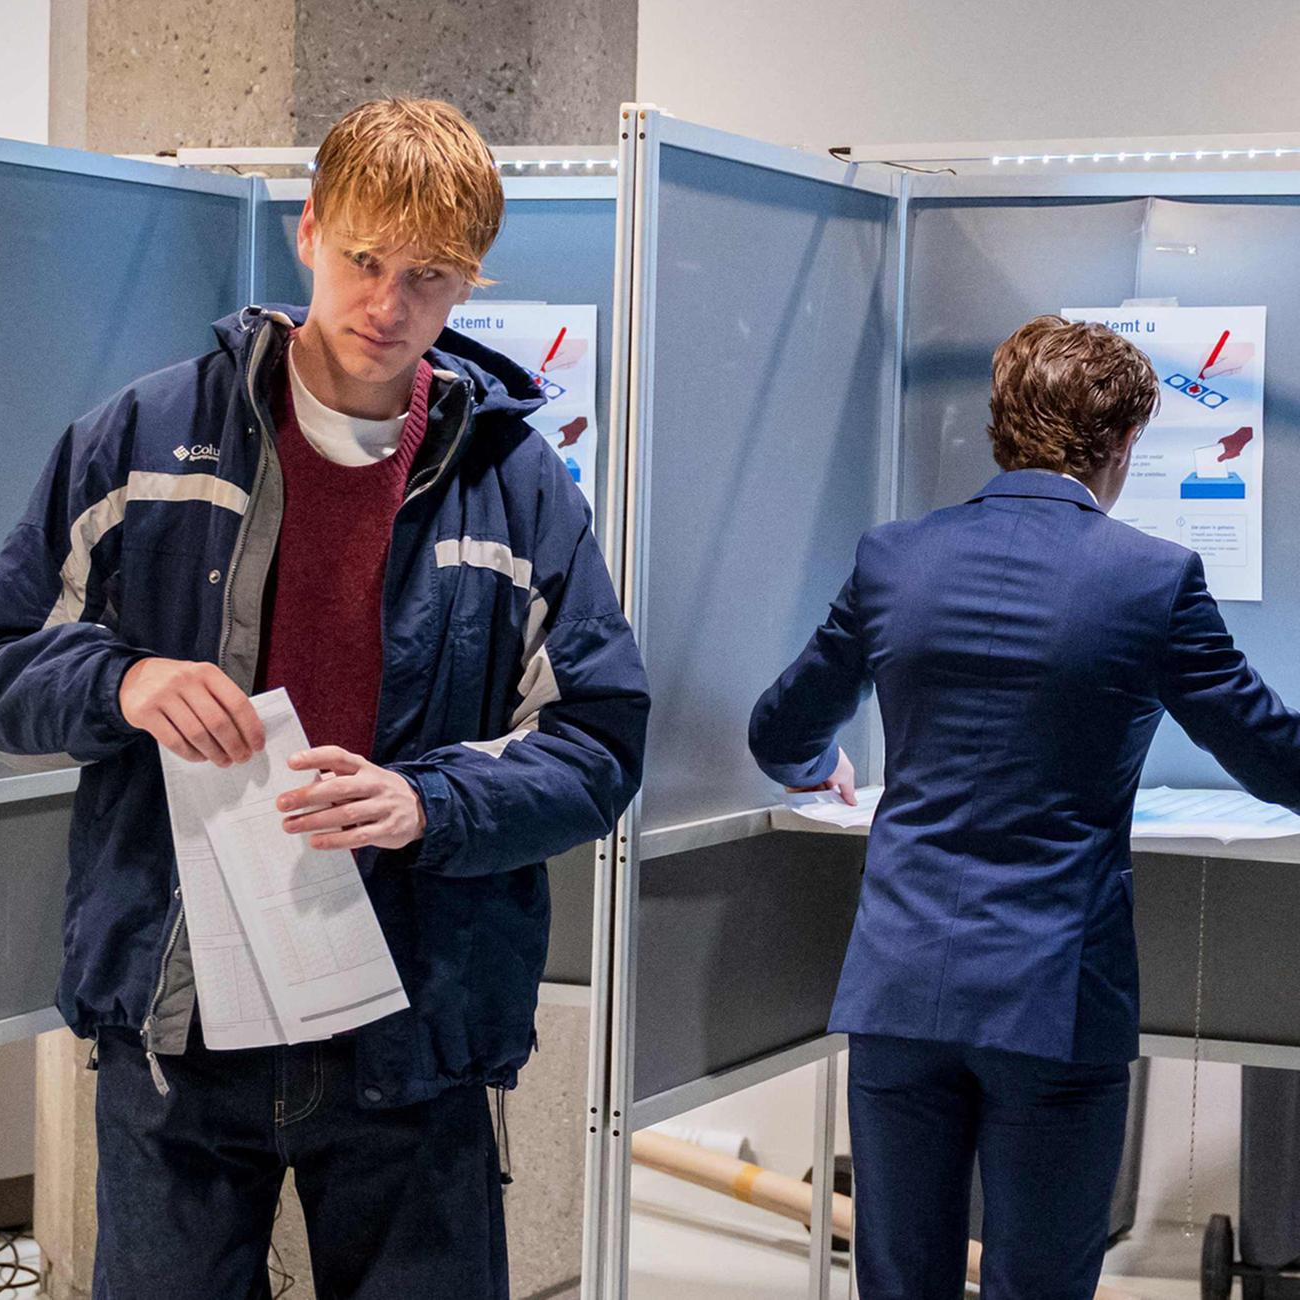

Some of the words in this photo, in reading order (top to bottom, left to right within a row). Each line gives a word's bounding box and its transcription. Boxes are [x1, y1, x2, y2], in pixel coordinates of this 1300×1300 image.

[452, 316, 491, 329] stemt
[496, 319, 504, 329] u
[1104, 319, 1140, 333] temt
[1146, 321, 1155, 333] u
[190, 443, 220, 456] Colu
